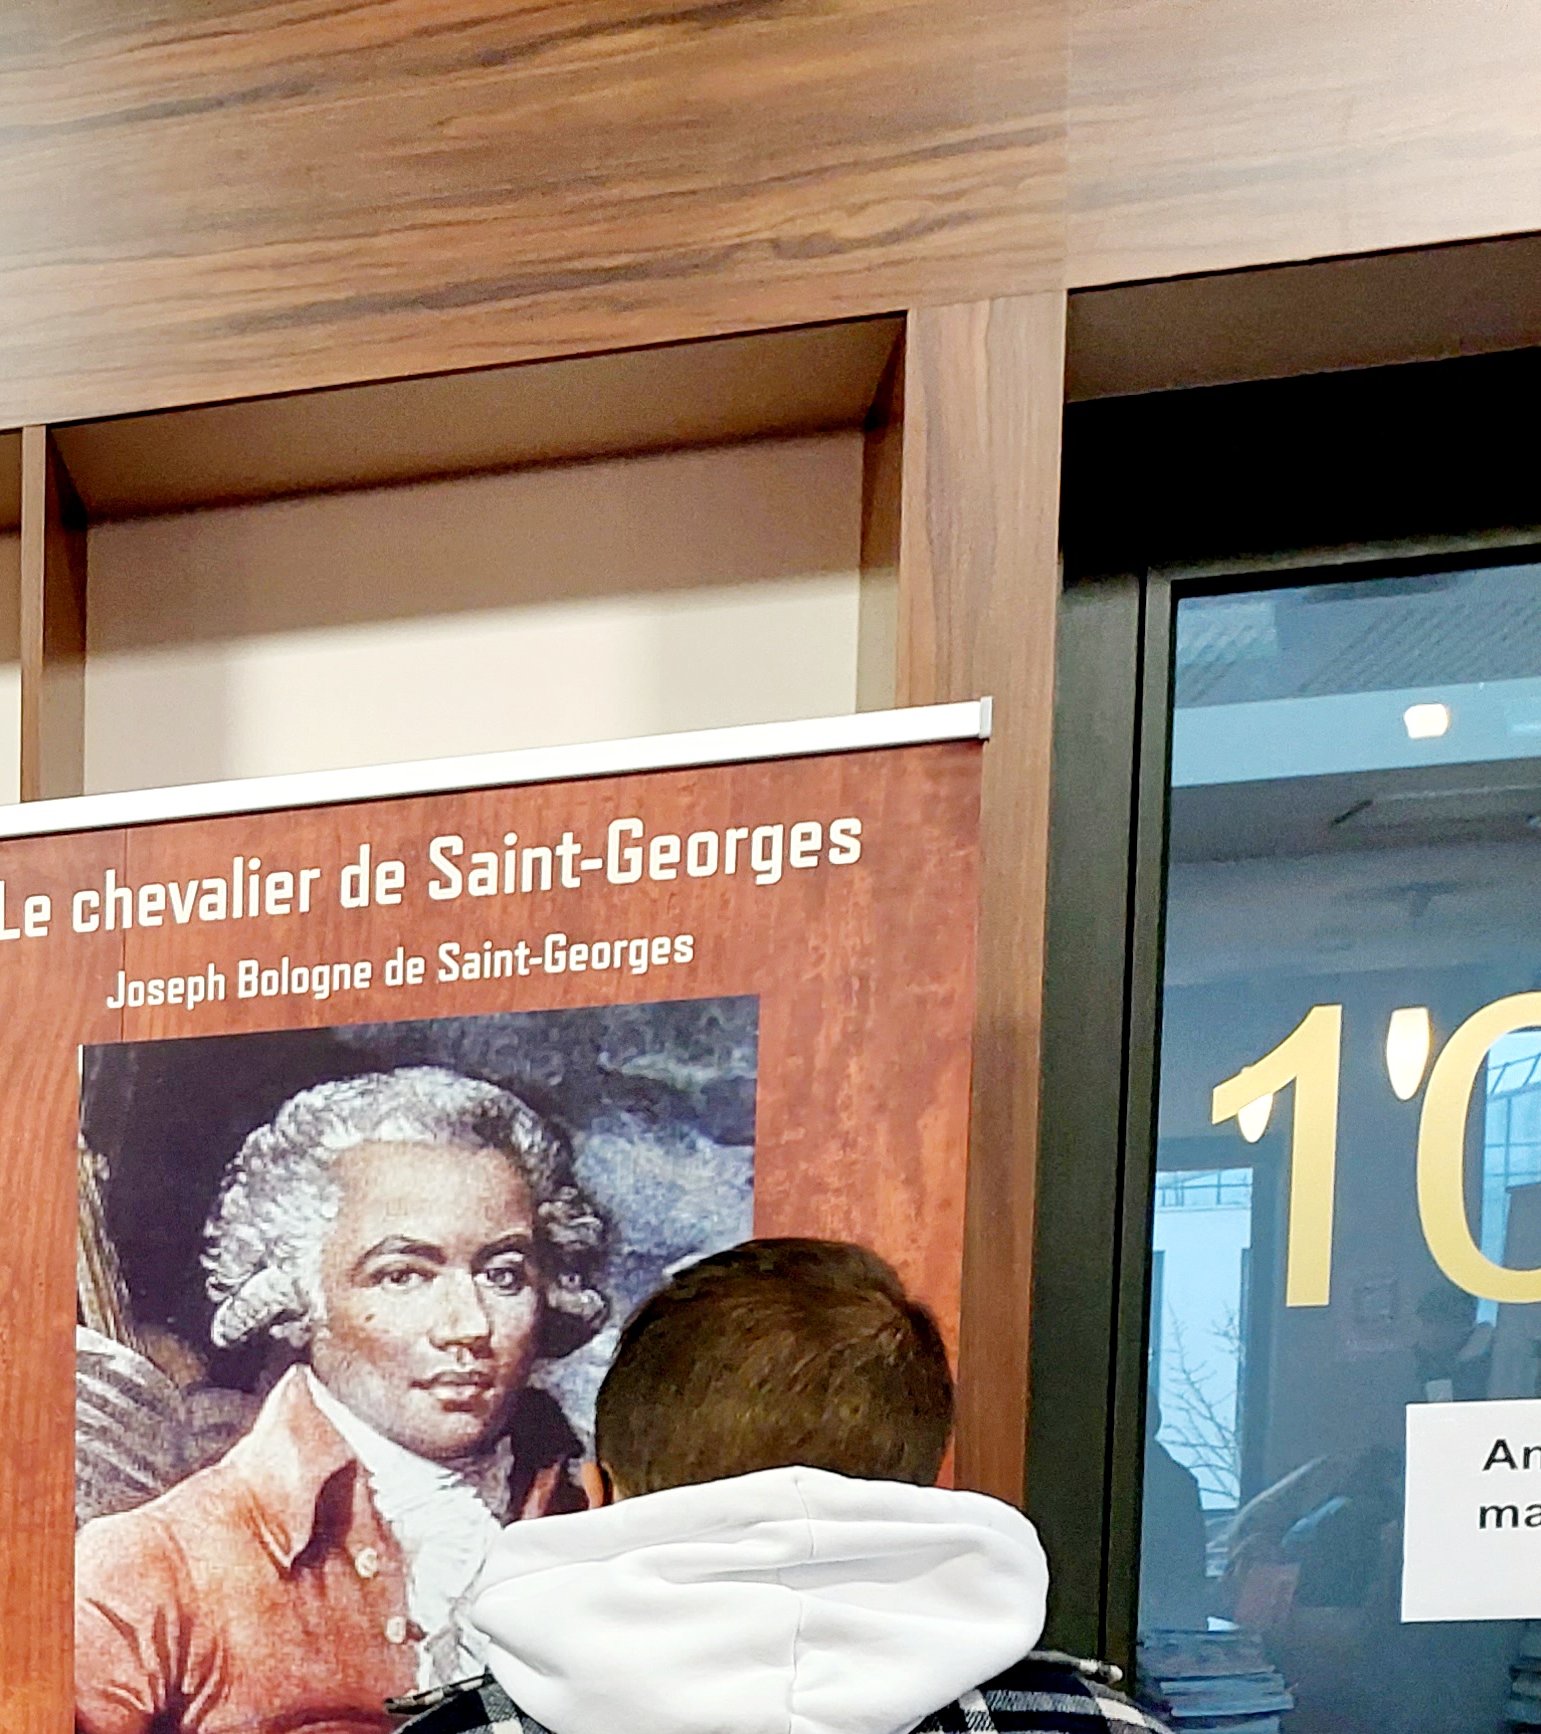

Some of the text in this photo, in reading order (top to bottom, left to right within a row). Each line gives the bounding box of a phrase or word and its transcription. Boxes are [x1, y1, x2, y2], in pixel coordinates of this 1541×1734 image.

[73, 857, 320, 932] chevalier
[341, 844, 404, 908] de
[429, 818, 861, 900] Saint-Georges
[107, 934, 693, 1010] Joseph Bologne de Saint-Georges
